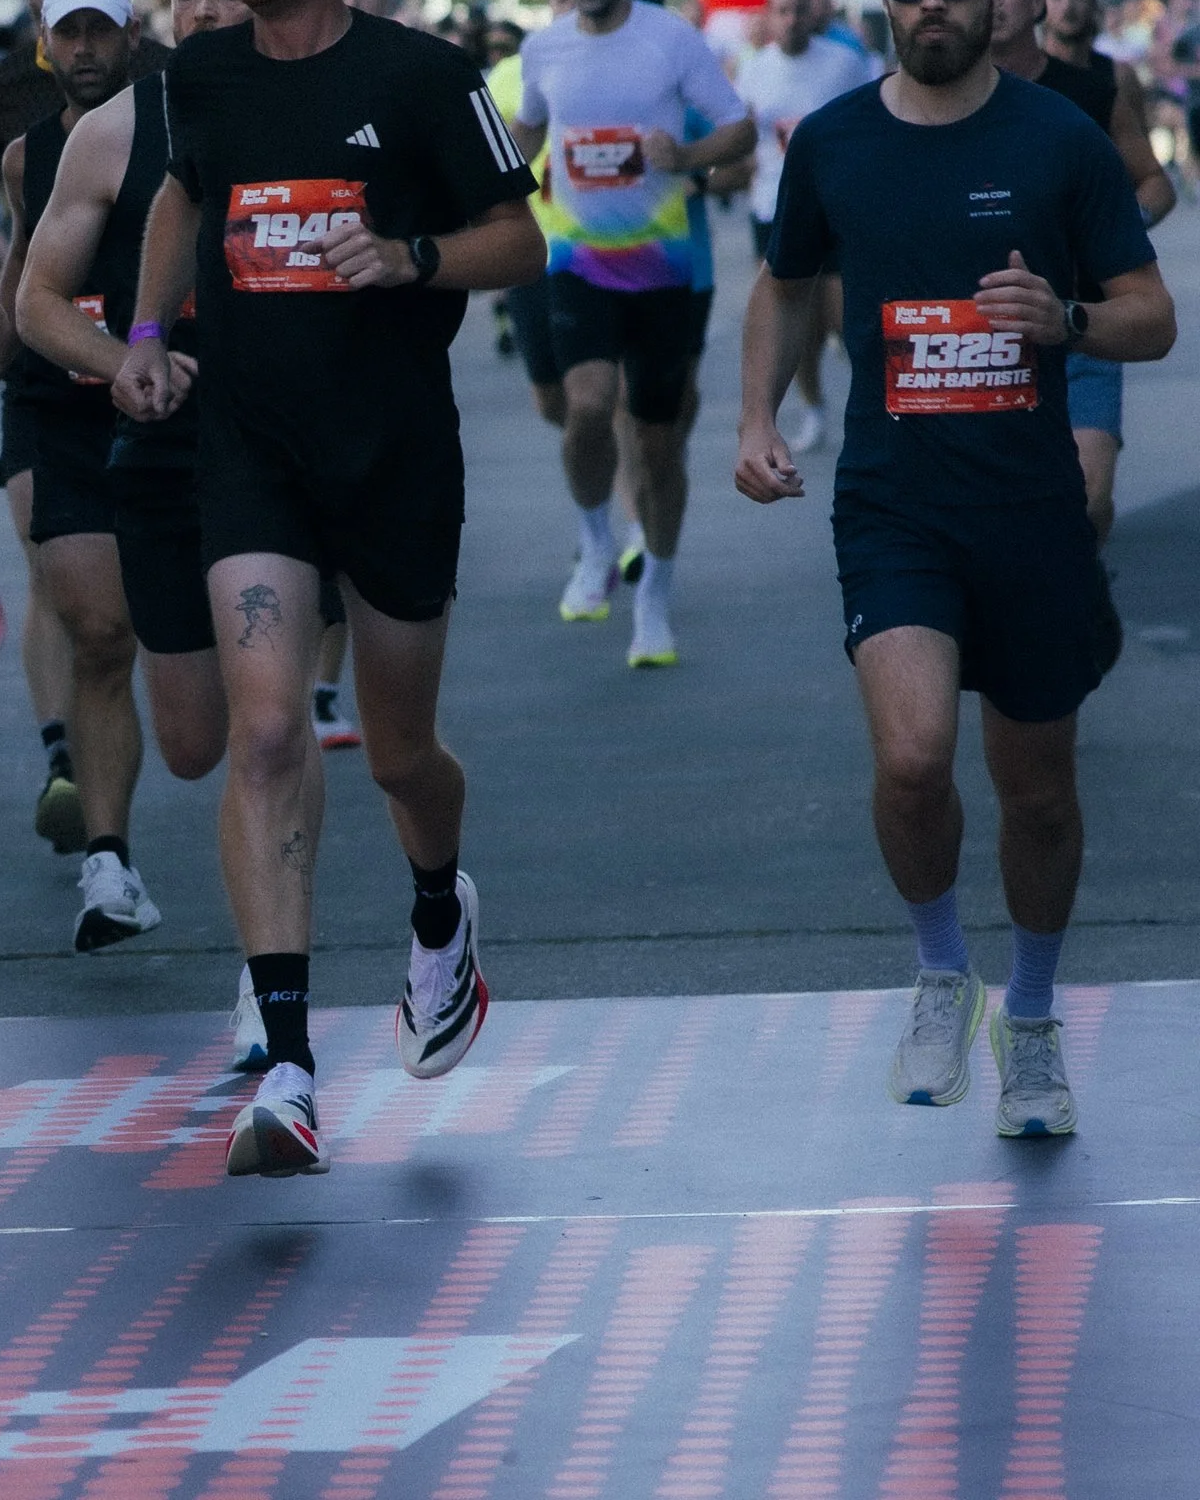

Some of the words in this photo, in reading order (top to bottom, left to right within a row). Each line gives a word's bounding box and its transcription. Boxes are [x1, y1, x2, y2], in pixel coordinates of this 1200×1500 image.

[331, 189, 355, 198] HEA
[909, 332, 1023, 369] 1325
[895, 368, 1032, 389] JEAN-BAPTISTE
